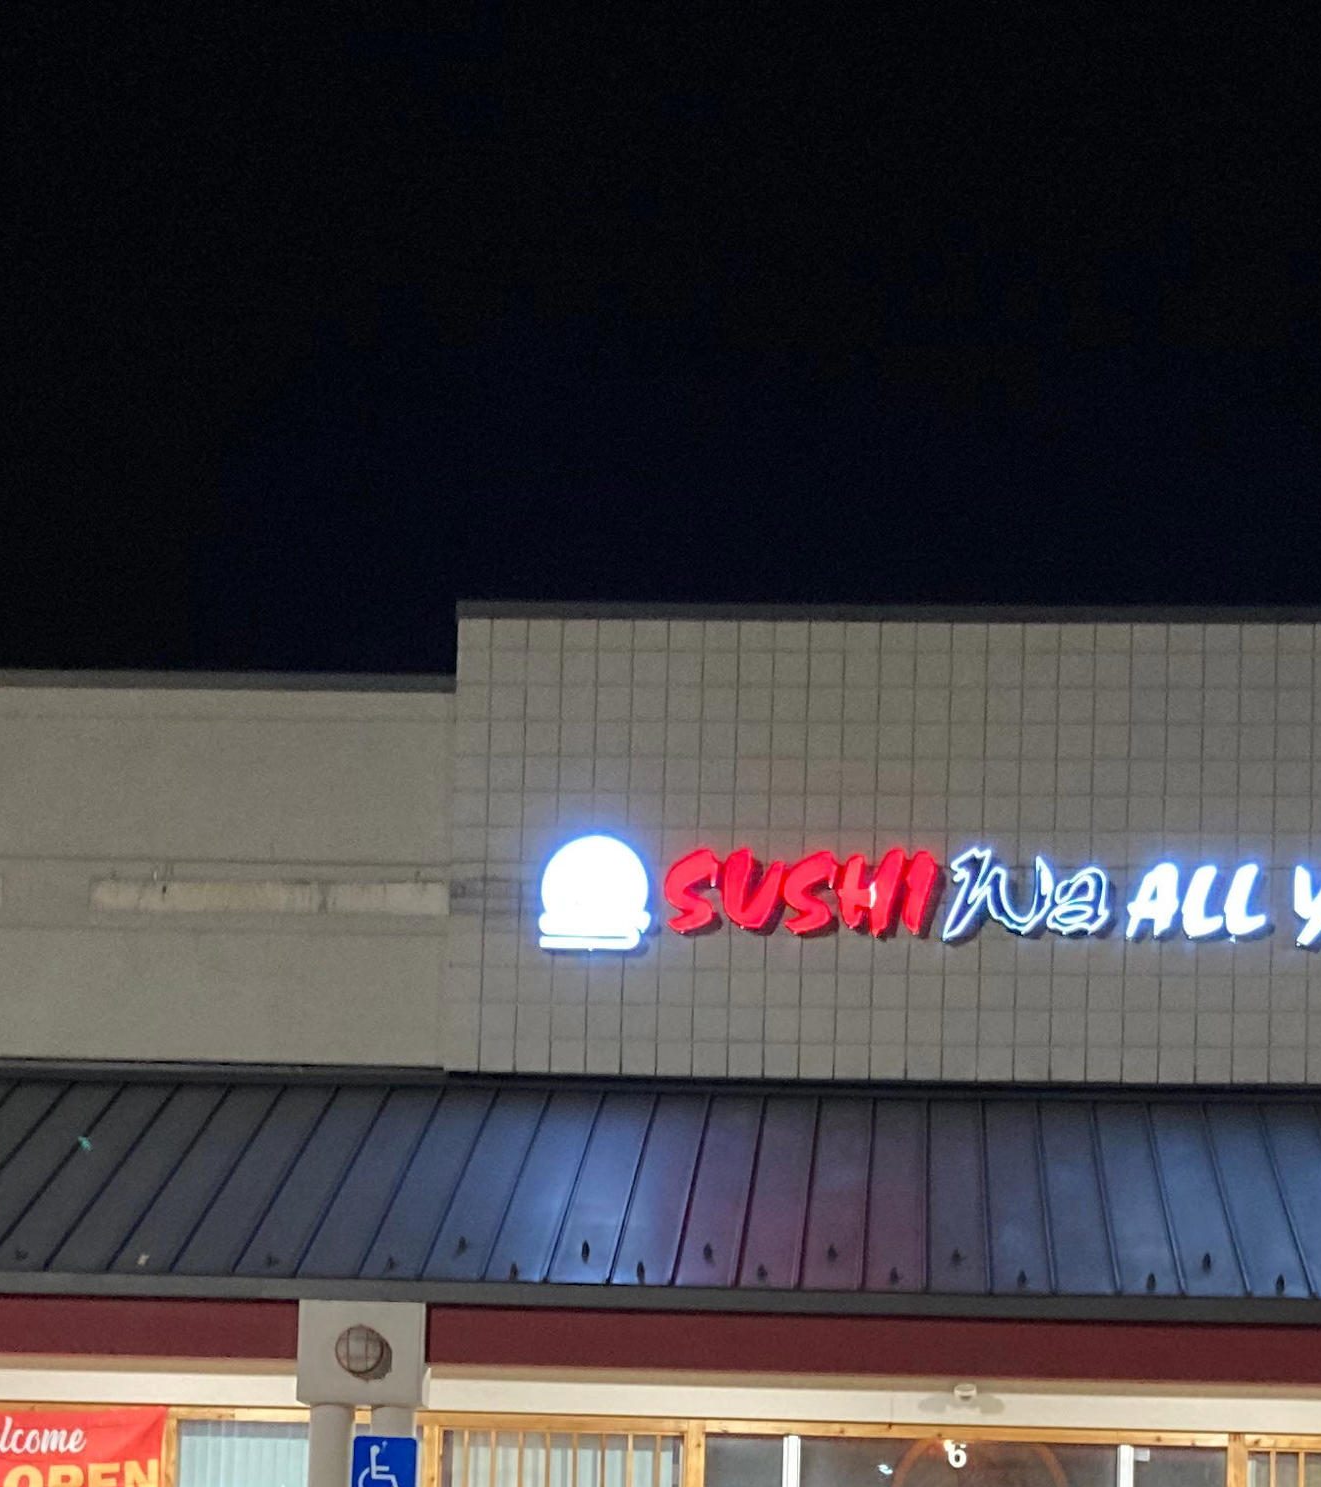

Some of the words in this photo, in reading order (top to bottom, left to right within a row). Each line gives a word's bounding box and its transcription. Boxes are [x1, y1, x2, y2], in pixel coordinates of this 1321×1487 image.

[664, 847, 939, 935] SUSHI
[1125, 862, 1267, 942] ALL
[948, 1443, 967, 1469] 6
